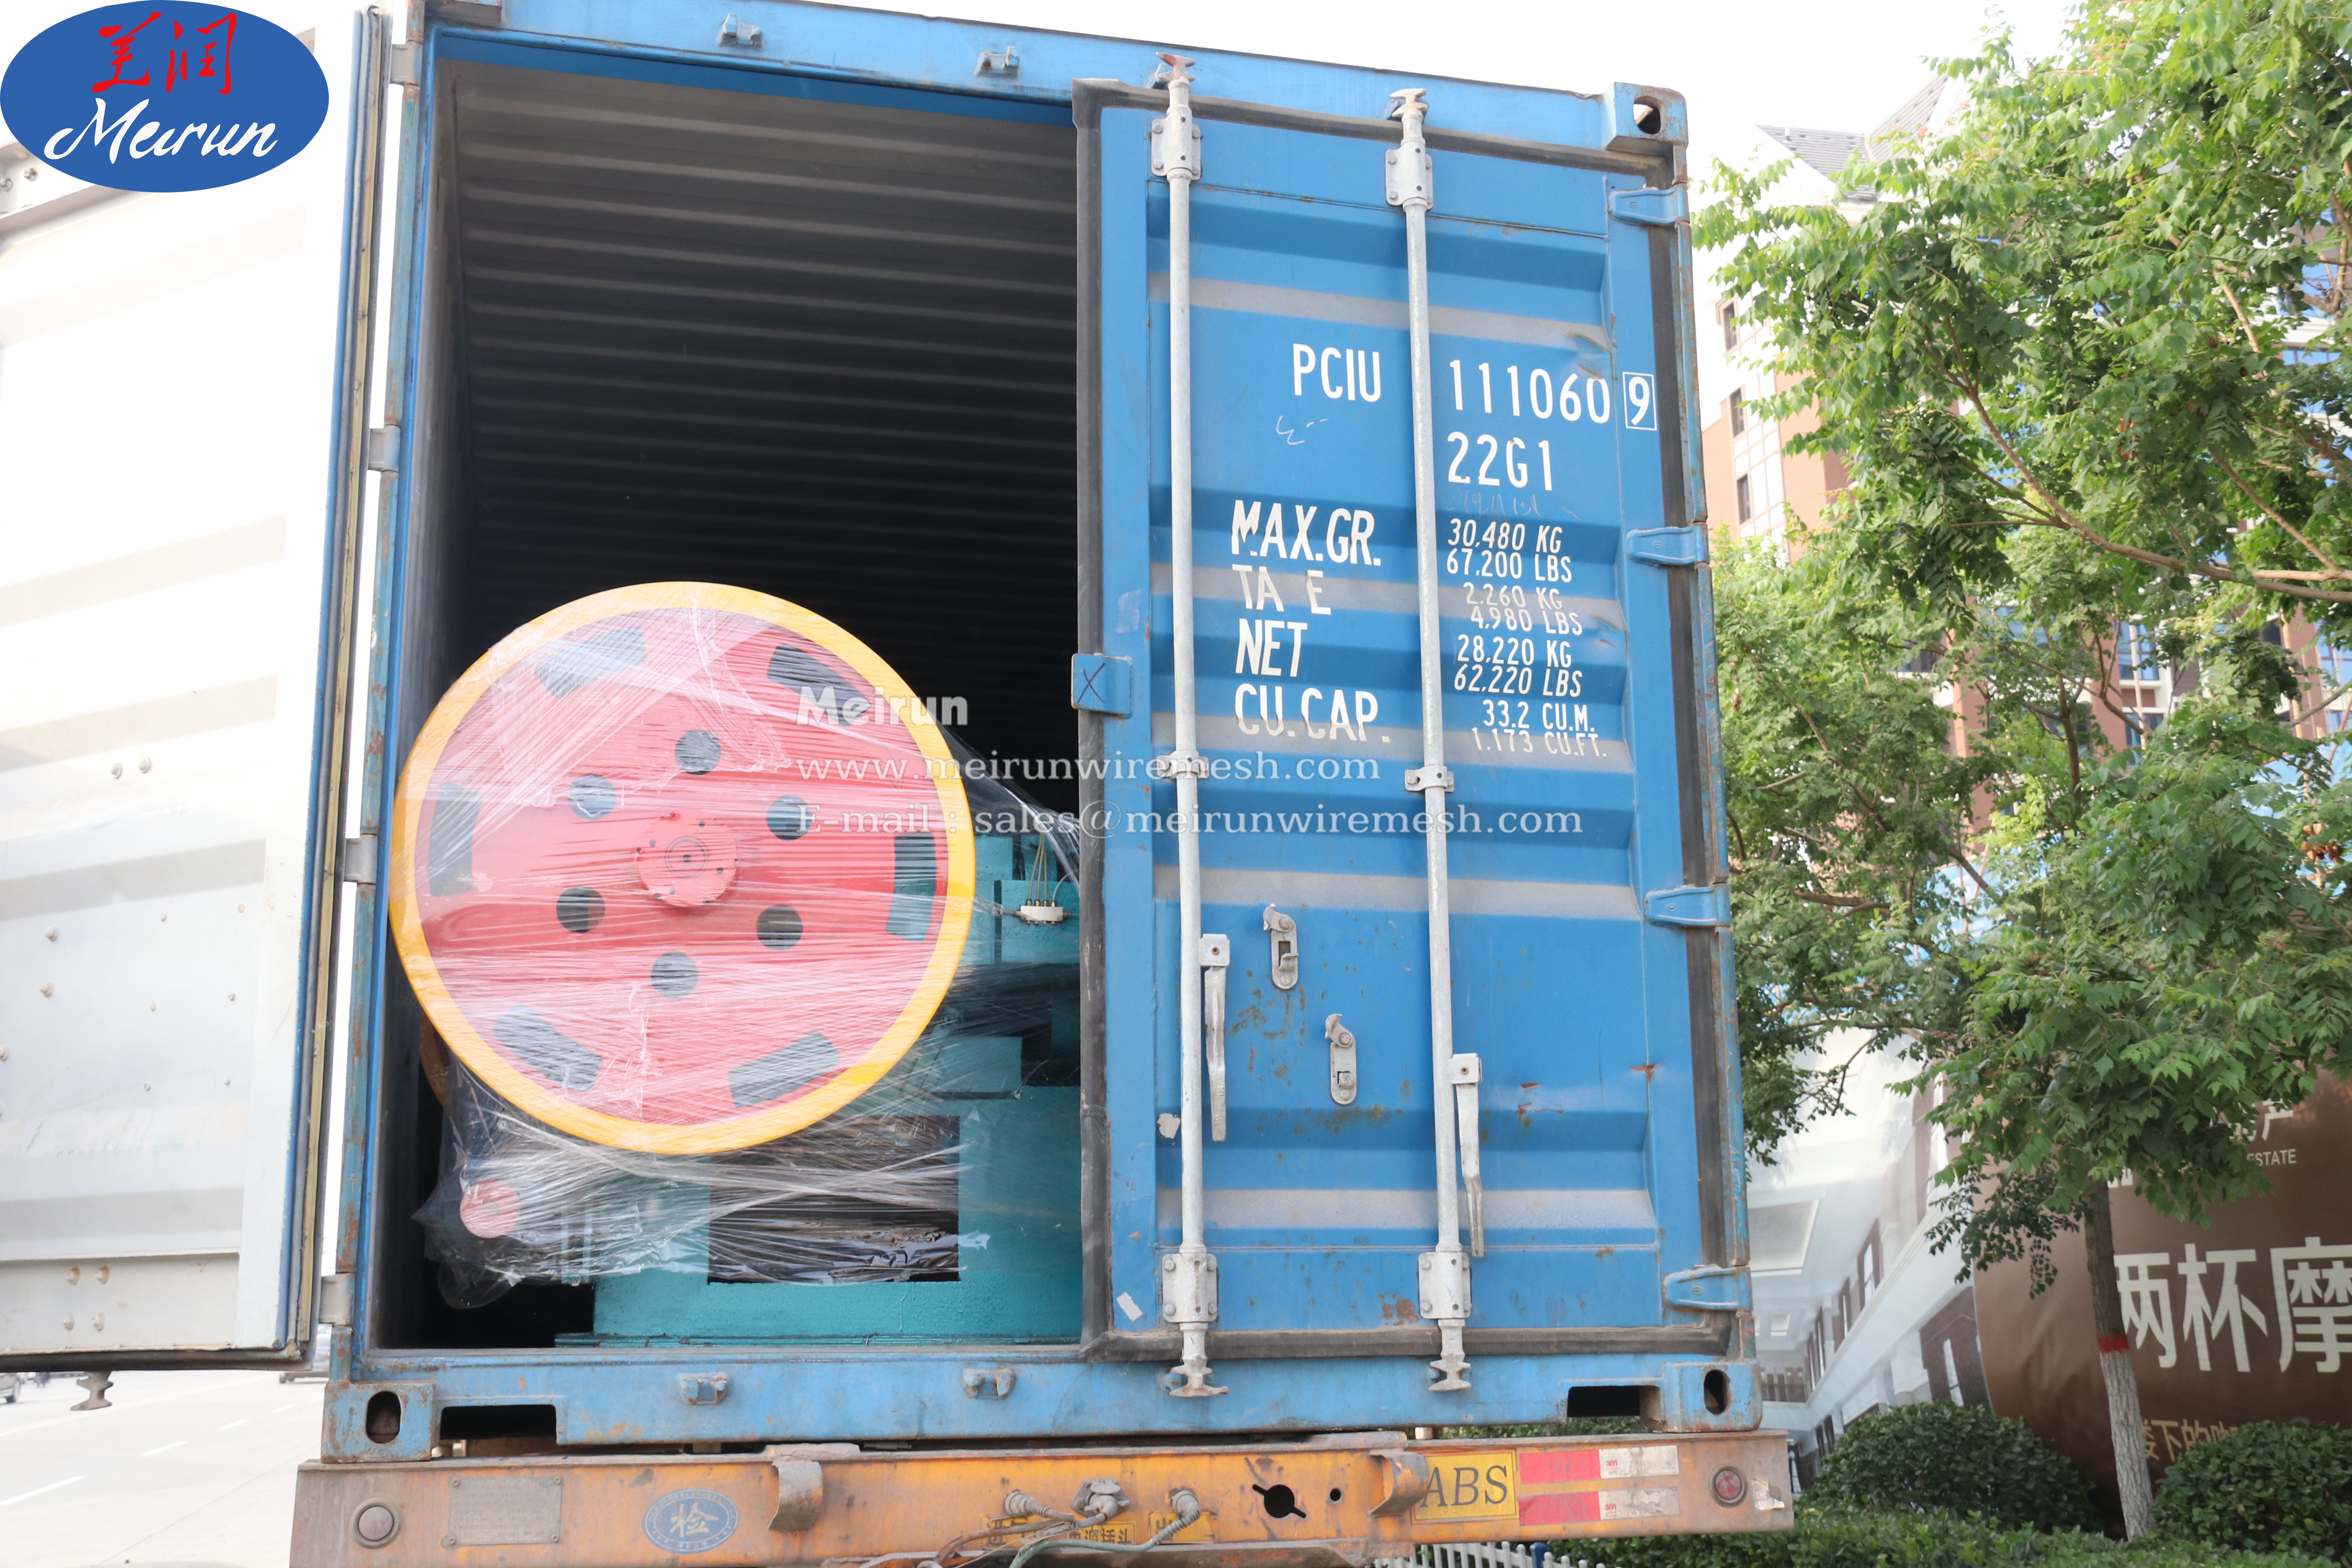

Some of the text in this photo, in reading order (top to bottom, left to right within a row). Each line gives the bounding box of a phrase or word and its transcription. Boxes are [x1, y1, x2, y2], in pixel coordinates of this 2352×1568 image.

[1293, 343, 1650, 426] PCIU 111060 9
[1447, 431, 1552, 491] 22G1
[1447, 518, 1526, 551] 30,480
[1535, 525, 1563, 554] KG
[1446, 548, 1573, 583] 67,200 LBS
[1535, 587, 1563, 610] KG
[1470, 605, 1583, 636] 4,980 LBS
[1235, 618, 1572, 677] NET 28,220 KG
[1454, 663, 1583, 697] 62,220 LBS
[1483, 699, 1530, 729] 33.2
[2113, 1236, 2352, 1374] 两杯摩
[1419, 1465, 1508, 1508] ABS
[669, 1502, 719, 1538] 检
